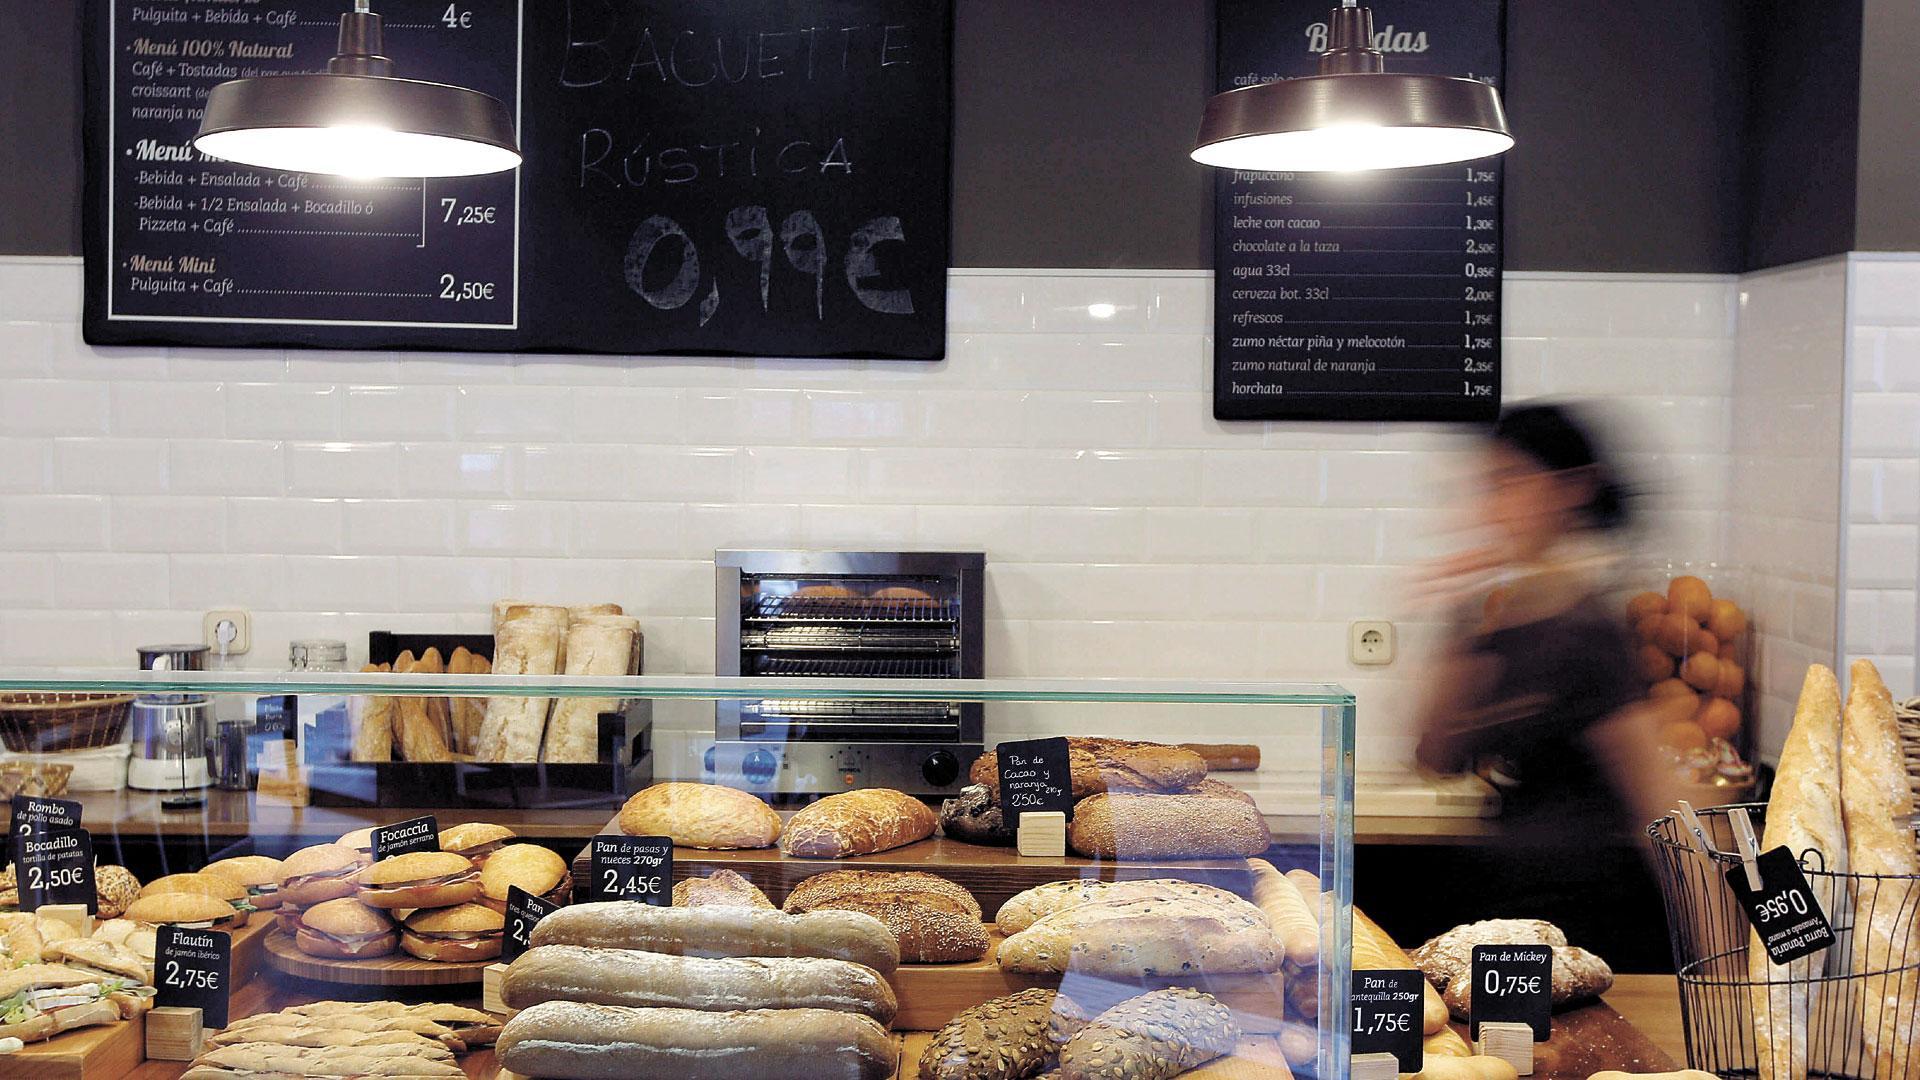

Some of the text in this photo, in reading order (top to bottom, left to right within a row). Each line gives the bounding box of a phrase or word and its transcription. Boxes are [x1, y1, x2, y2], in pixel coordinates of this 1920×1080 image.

[132, 7, 188, 26] Pulguita
[205, 9, 249, 24] Bebida
[266, 10, 297, 28] Café
[441, 3, 472, 29] 4€
[1305, 22, 1429, 53] Bdas
[133, 38, 294, 58] Menú 100% Natural
[132, 61, 162, 80] Café
[179, 62, 238, 78] Tostadas
[131, 85, 191, 98] croissant
[132, 105, 183, 122] naranja
[136, 138, 194, 161] Menú
[201, 171, 261, 187] Ensalada
[277, 174, 308, 192] Café
[1466, 167, 1495, 183] 1,75€
[1232, 191, 1495, 208] infusiones 1,45€
[201, 197, 223, 212] 1/2
[227, 198, 287, 213] Ensalada
[304, 200, 362, 214] Bocadillo
[365, 201, 374, 215] ó
[440, 197, 497, 226] 7,25€
[139, 217, 186, 232] Pizzeta
[203, 218, 235, 236] Café
[1233, 215, 1495, 231] leche con cacao 1,30€
[1232, 239, 1287, 252] chocolate
[1289, 243, 1297, 252] a
[1300, 240, 1311, 252] la
[1314, 242, 1340, 252] taza
[130, 254, 216, 273] Menú Mini
[624, 205, 914, 327] 0,99€
[1232, 263, 1495, 279] agua 33cl 0,95€
[130, 277, 186, 295] Pulguita
[203, 279, 234, 297] Café
[439, 273, 495, 302] 2,50€
[1232, 286, 1495, 301] cerveza bot. 33cl 2,00€
[1232, 310, 1493, 327] refrescos 1,75€
[1231, 333, 1493, 351] zumo néctar piña y melocotón 1,75€
[1231, 357, 1494, 374] zumo natural de naranja 2,35€
[1231, 381, 1493, 397] horchata 1,75€
[1009, 755, 1044, 766] Pan de
[1043, 769, 1050, 780] y
[1009, 781, 1048, 792] naranja
[28, 801, 65, 815] Rombo
[17, 811, 74, 826] de pollo asado
[381, 822, 429, 843] Focaccia
[25, 836, 78, 853] Bocadillo
[378, 833, 434, 853] de jamón serrano
[596, 842, 669, 856] Pan de pasas y
[23, 850, 84, 863] tortilla de patatas
[601, 856, 664, 867] nueces 270gr
[28, 867, 84, 890] 2,50€
[603, 869, 662, 896] 2,45€
[509, 903, 520, 914] tres
[527, 898, 543, 915] Pan
[1755, 889, 1808, 922] 0,95€
[172, 932, 213, 948] Flautín
[1771, 926, 1829, 957] Barra Panaria
[165, 947, 220, 960] de jamón ibérico
[1479, 951, 1547, 964] Pan de Mickey
[165, 960, 219, 989] 2,75€
[1364, 977, 1398, 989] Pan de
[1485, 969, 1541, 996] 0,75€
[1351, 991, 1419, 1003] antequilla 250gr
[1353, 1007, 1410, 1034] 1,75€
